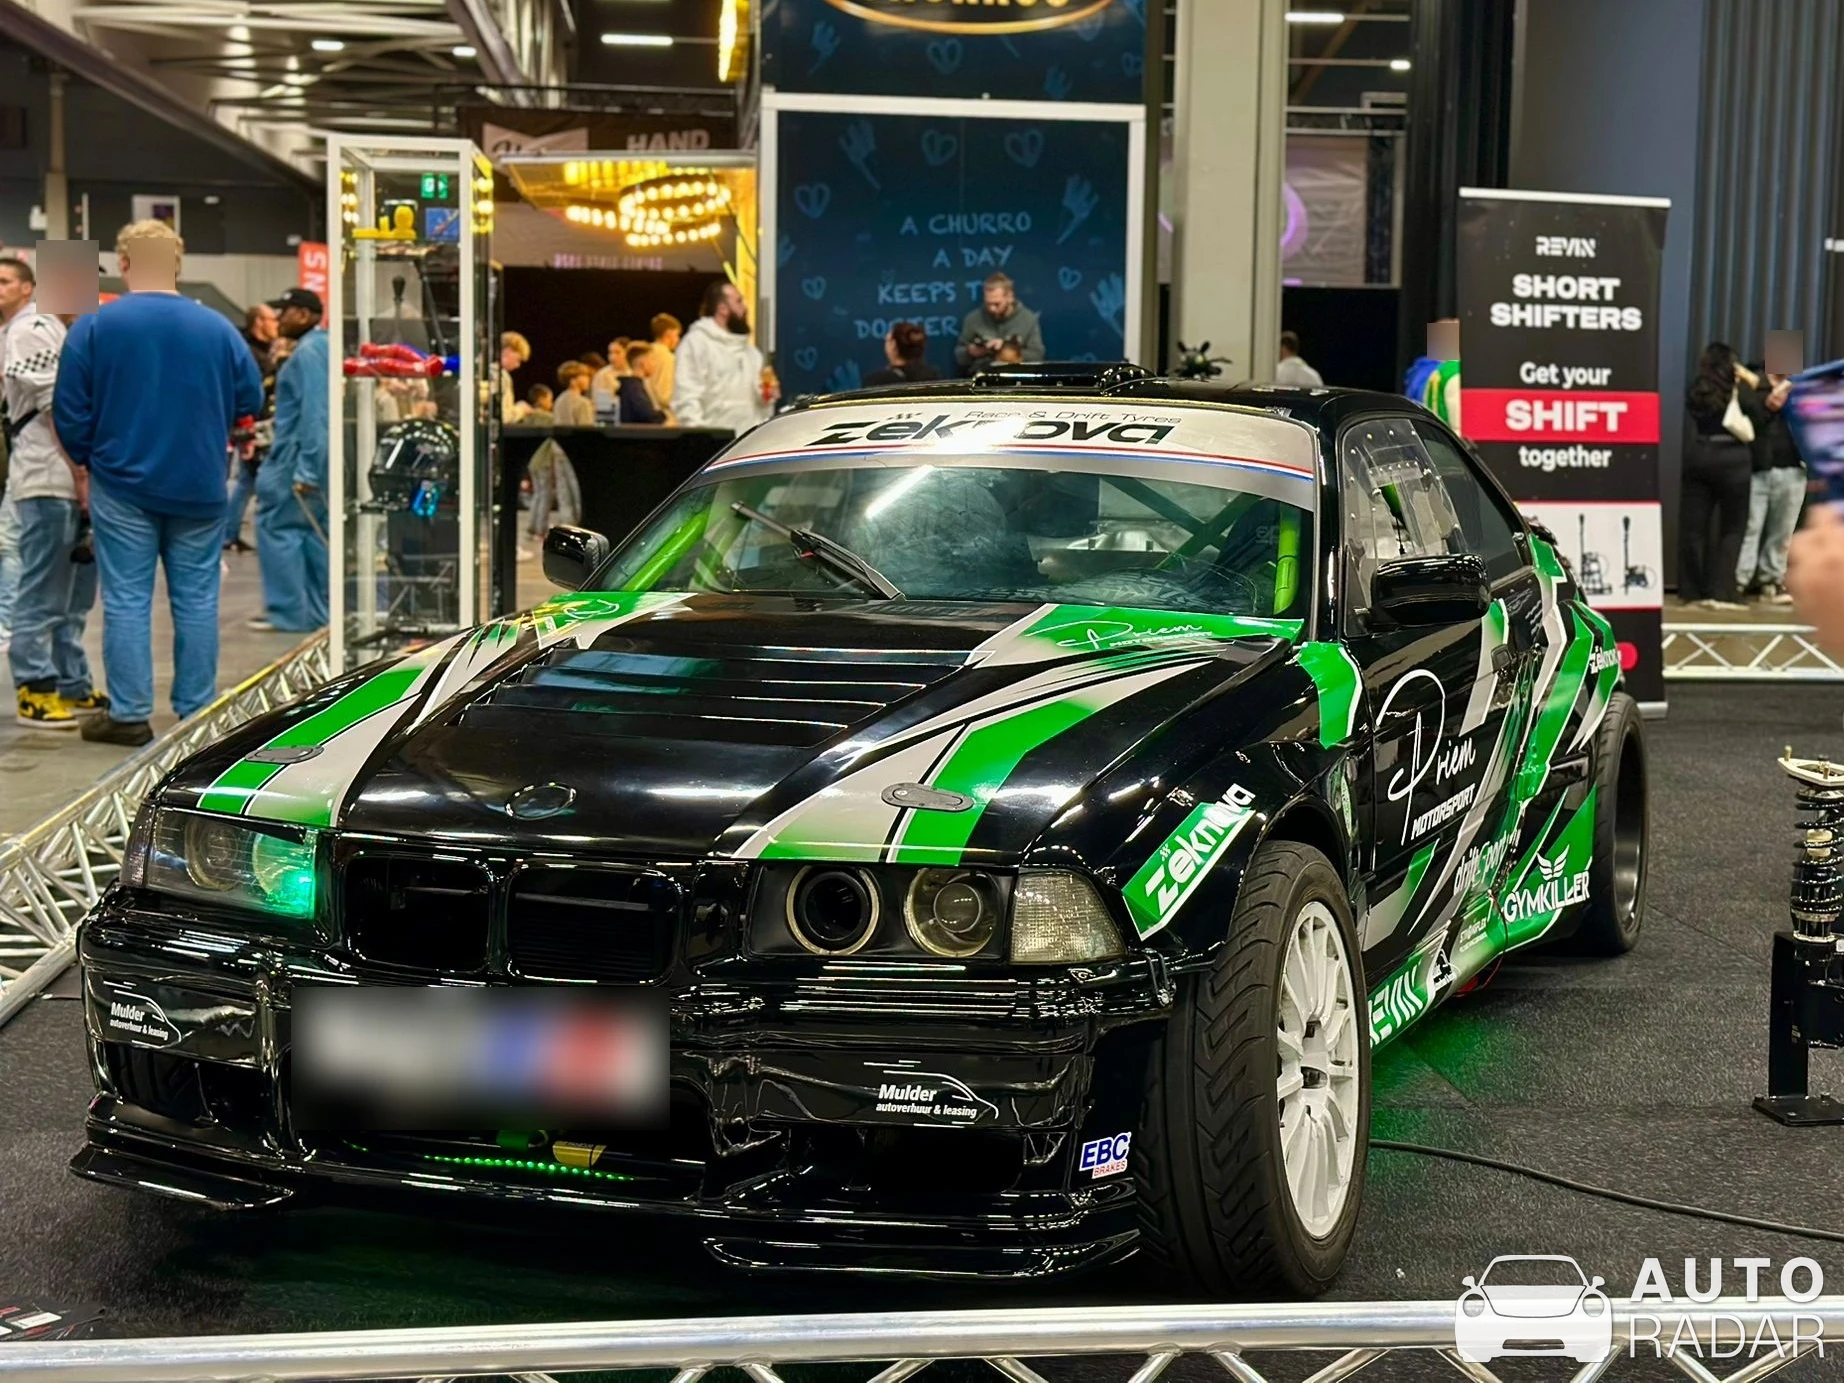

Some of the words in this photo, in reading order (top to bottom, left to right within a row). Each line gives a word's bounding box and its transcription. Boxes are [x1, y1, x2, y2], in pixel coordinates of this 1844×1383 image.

[900, 216, 919, 235] A
[928, 212, 1032, 235] CHURRO
[932, 249, 951, 268] A
[961, 244, 1014, 268] DAY
[1535, 235, 1597, 258] REVIN
[878, 281, 957, 305] KEEPS
[1512, 273, 1621, 301] SHORT
[1490, 301, 1643, 331] SHIFTERS
[1519, 361, 1560, 385] Get
[1562, 366, 1612, 390] your
[1028, 411, 1047, 419] &
[1055, 410, 1112, 421] Drift
[1121, 413, 1182, 424] Tyres
[1505, 398, 1629, 433] SHIFT
[1518, 444, 1613, 472] together
[1411, 782, 1476, 841] MOTORSPORT
[1503, 870, 1590, 922] GYMKILLER
[110, 1001, 145, 1022] Mulder
[149, 1026, 168, 1040] leasing
[878, 1083, 937, 1102] Mulder
[876, 1102, 932, 1115] autoverhuur
[933, 1103, 942, 1115] &
[943, 1104, 977, 1120] leasing
[1081, 1133, 1131, 1169] EBC
[1093, 1160, 1127, 1178] BRAKES
